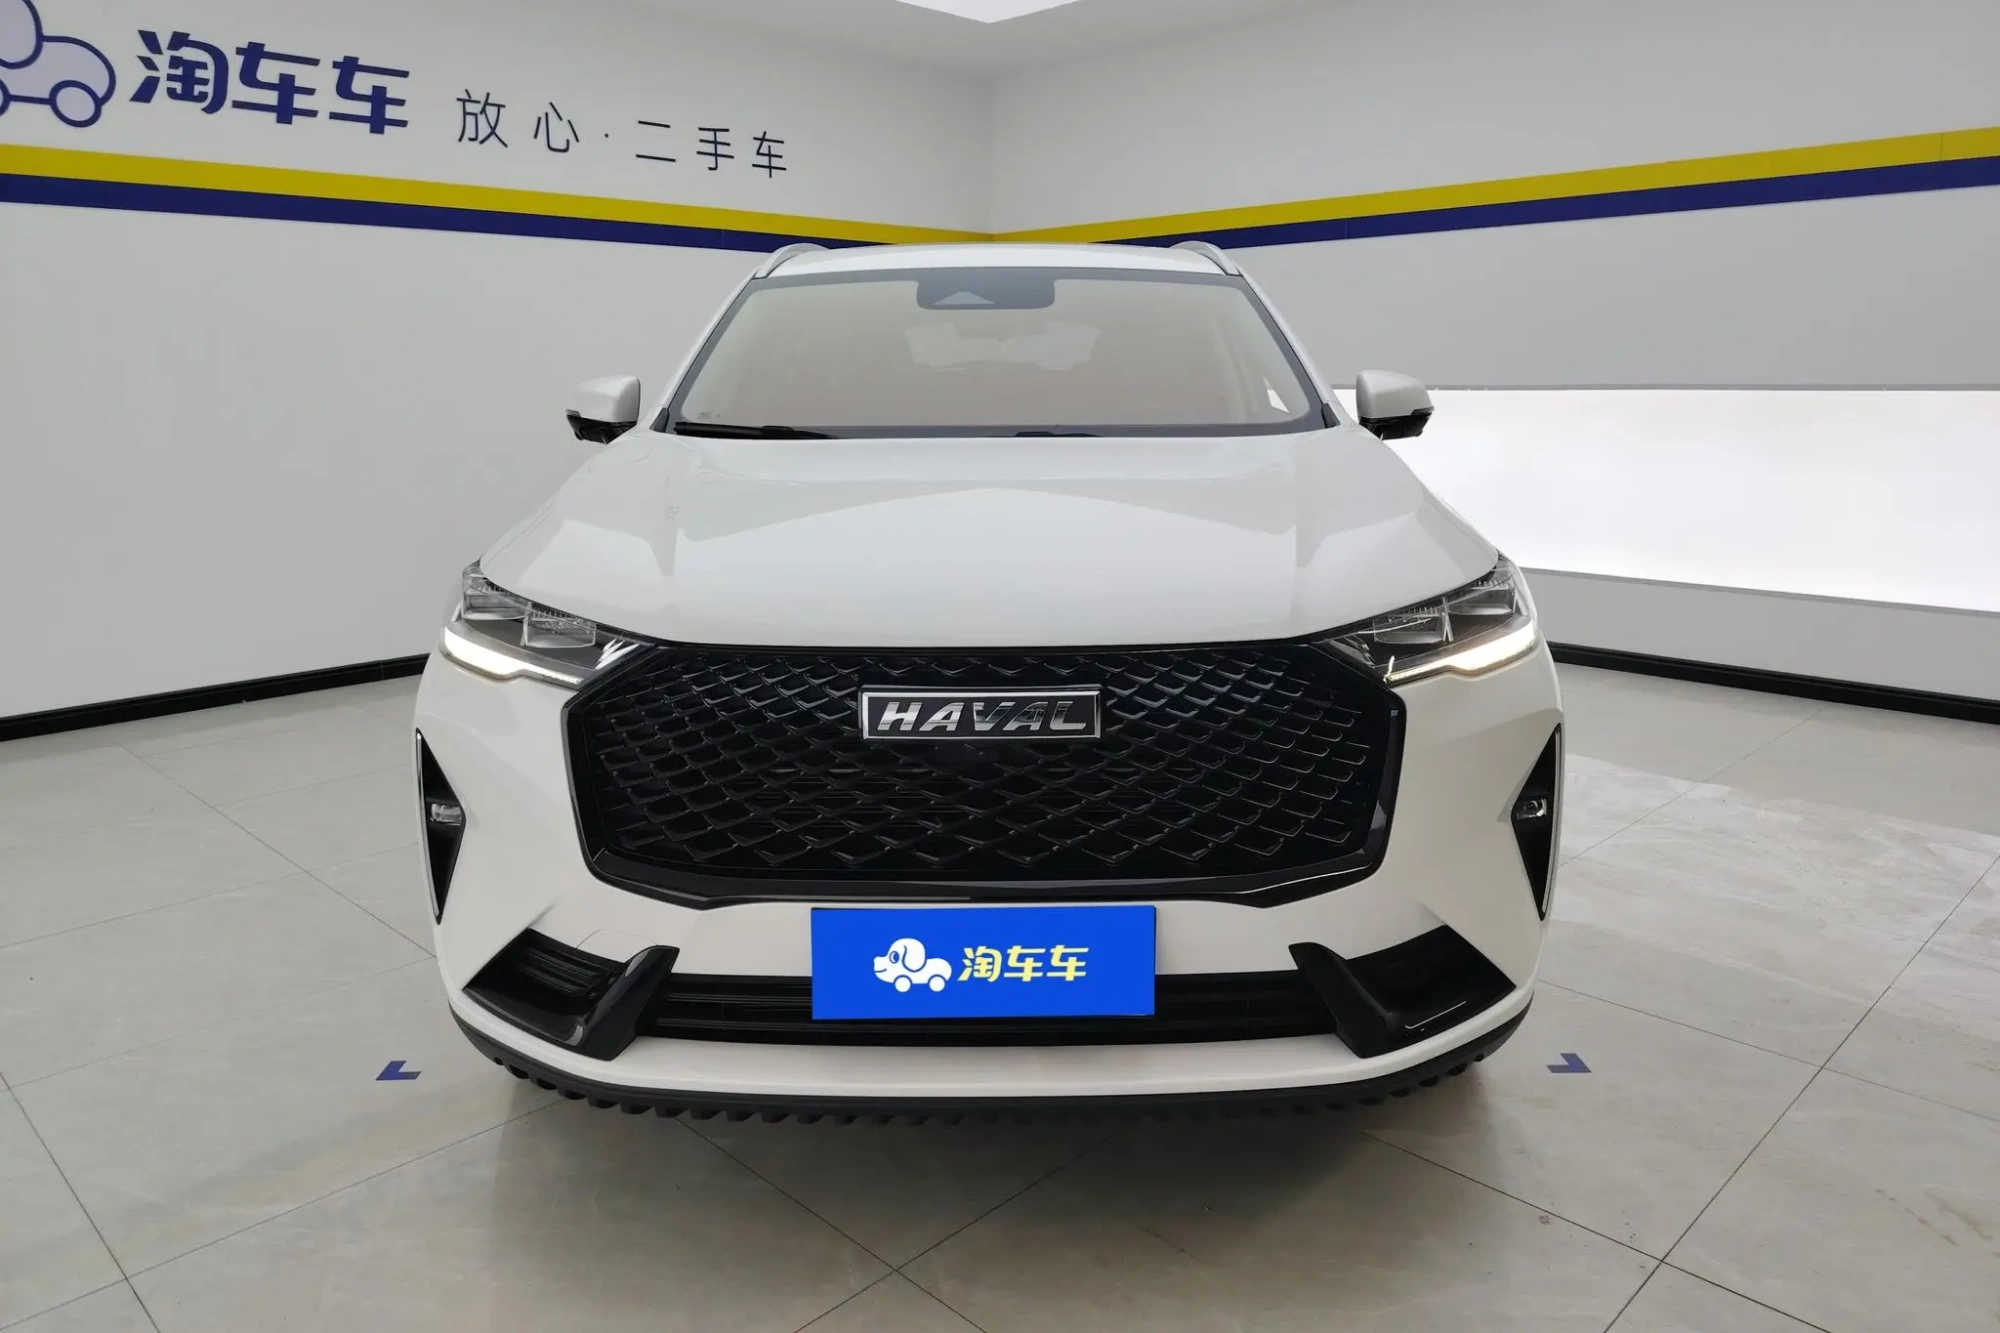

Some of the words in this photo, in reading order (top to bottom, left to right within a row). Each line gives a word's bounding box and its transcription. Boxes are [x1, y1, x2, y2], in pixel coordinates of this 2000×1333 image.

[129, 29, 410, 135] 淘车车
[877, 700, 1087, 732] HAVAL
[957, 944, 1089, 982] 淘车车
